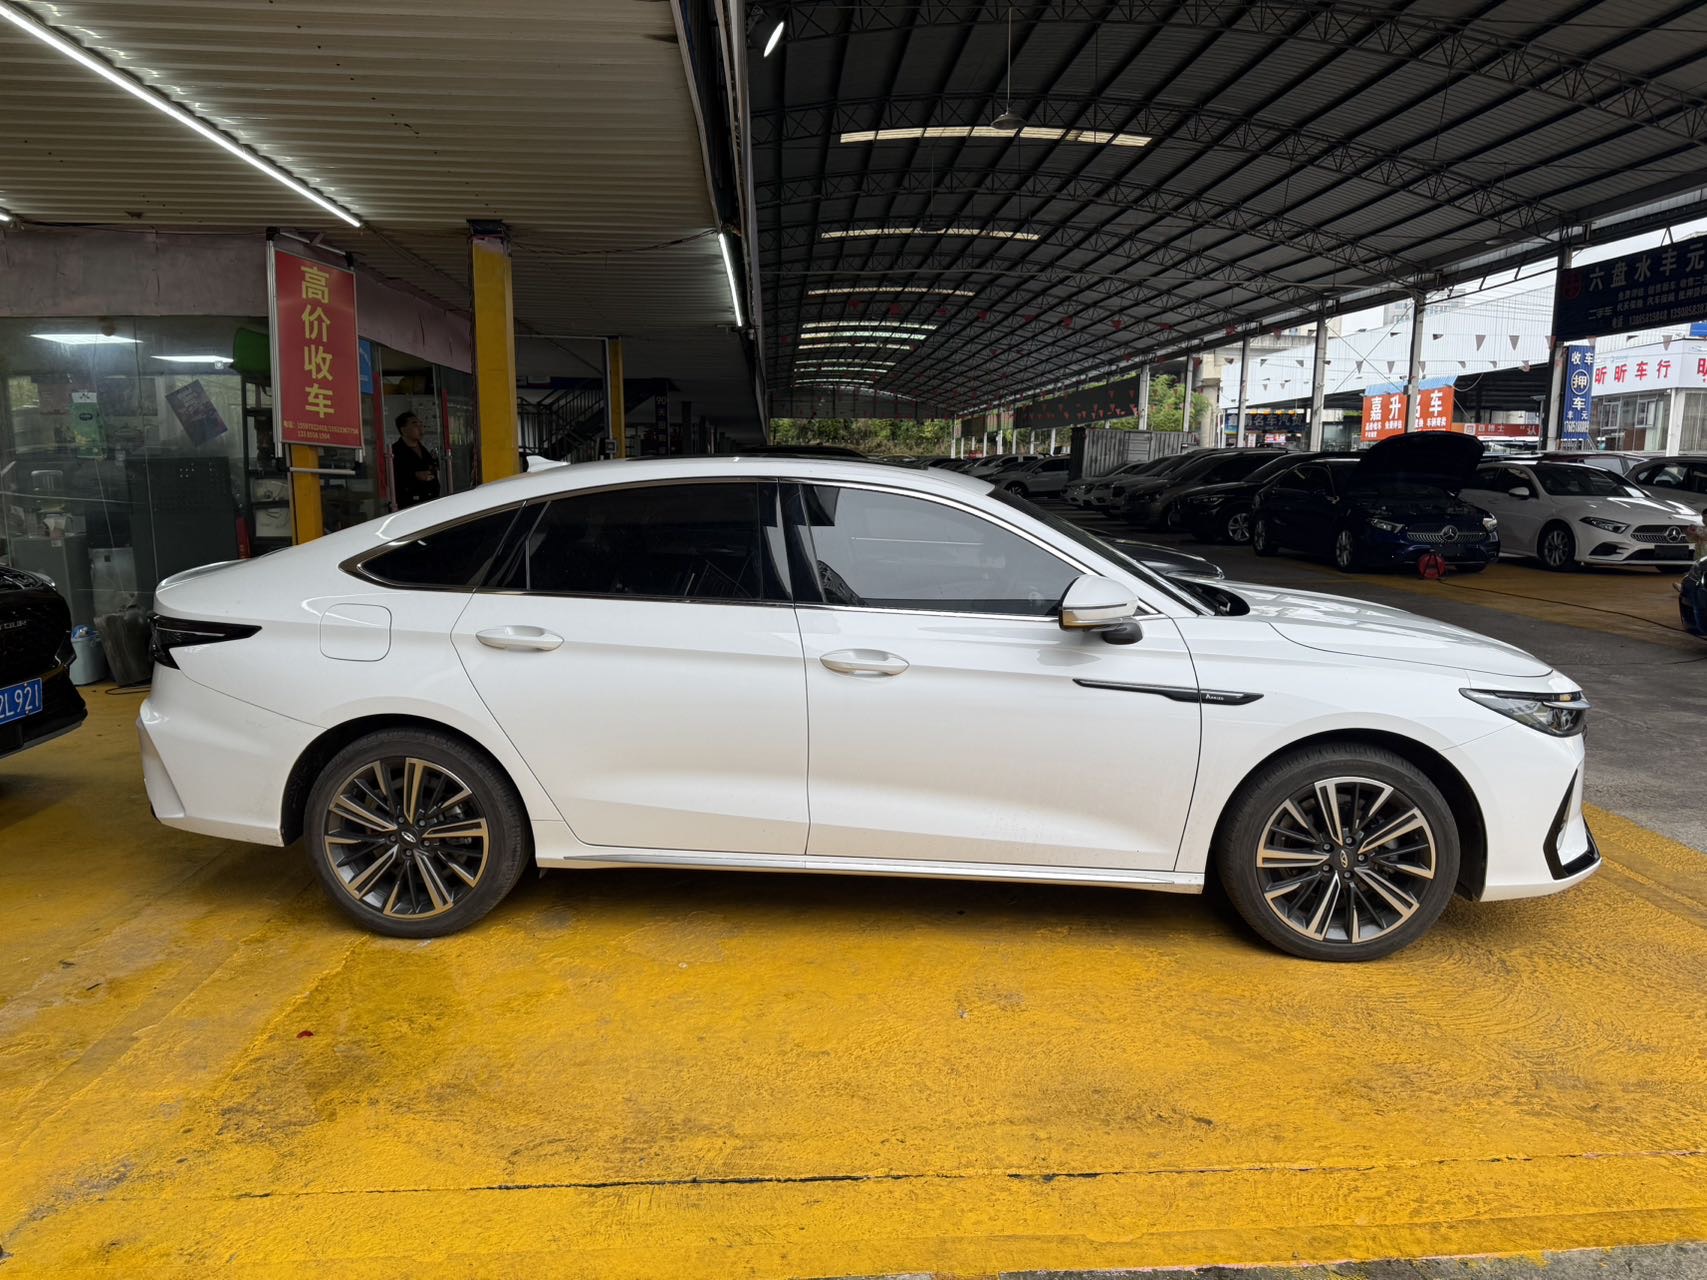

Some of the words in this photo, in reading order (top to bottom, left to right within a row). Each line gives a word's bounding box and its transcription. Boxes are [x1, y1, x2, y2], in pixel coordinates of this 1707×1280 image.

[300, 266, 336, 419] 高价收车
[1571, 351, 1594, 365] 收车
[1594, 359, 1672, 385] 昕昕车行
